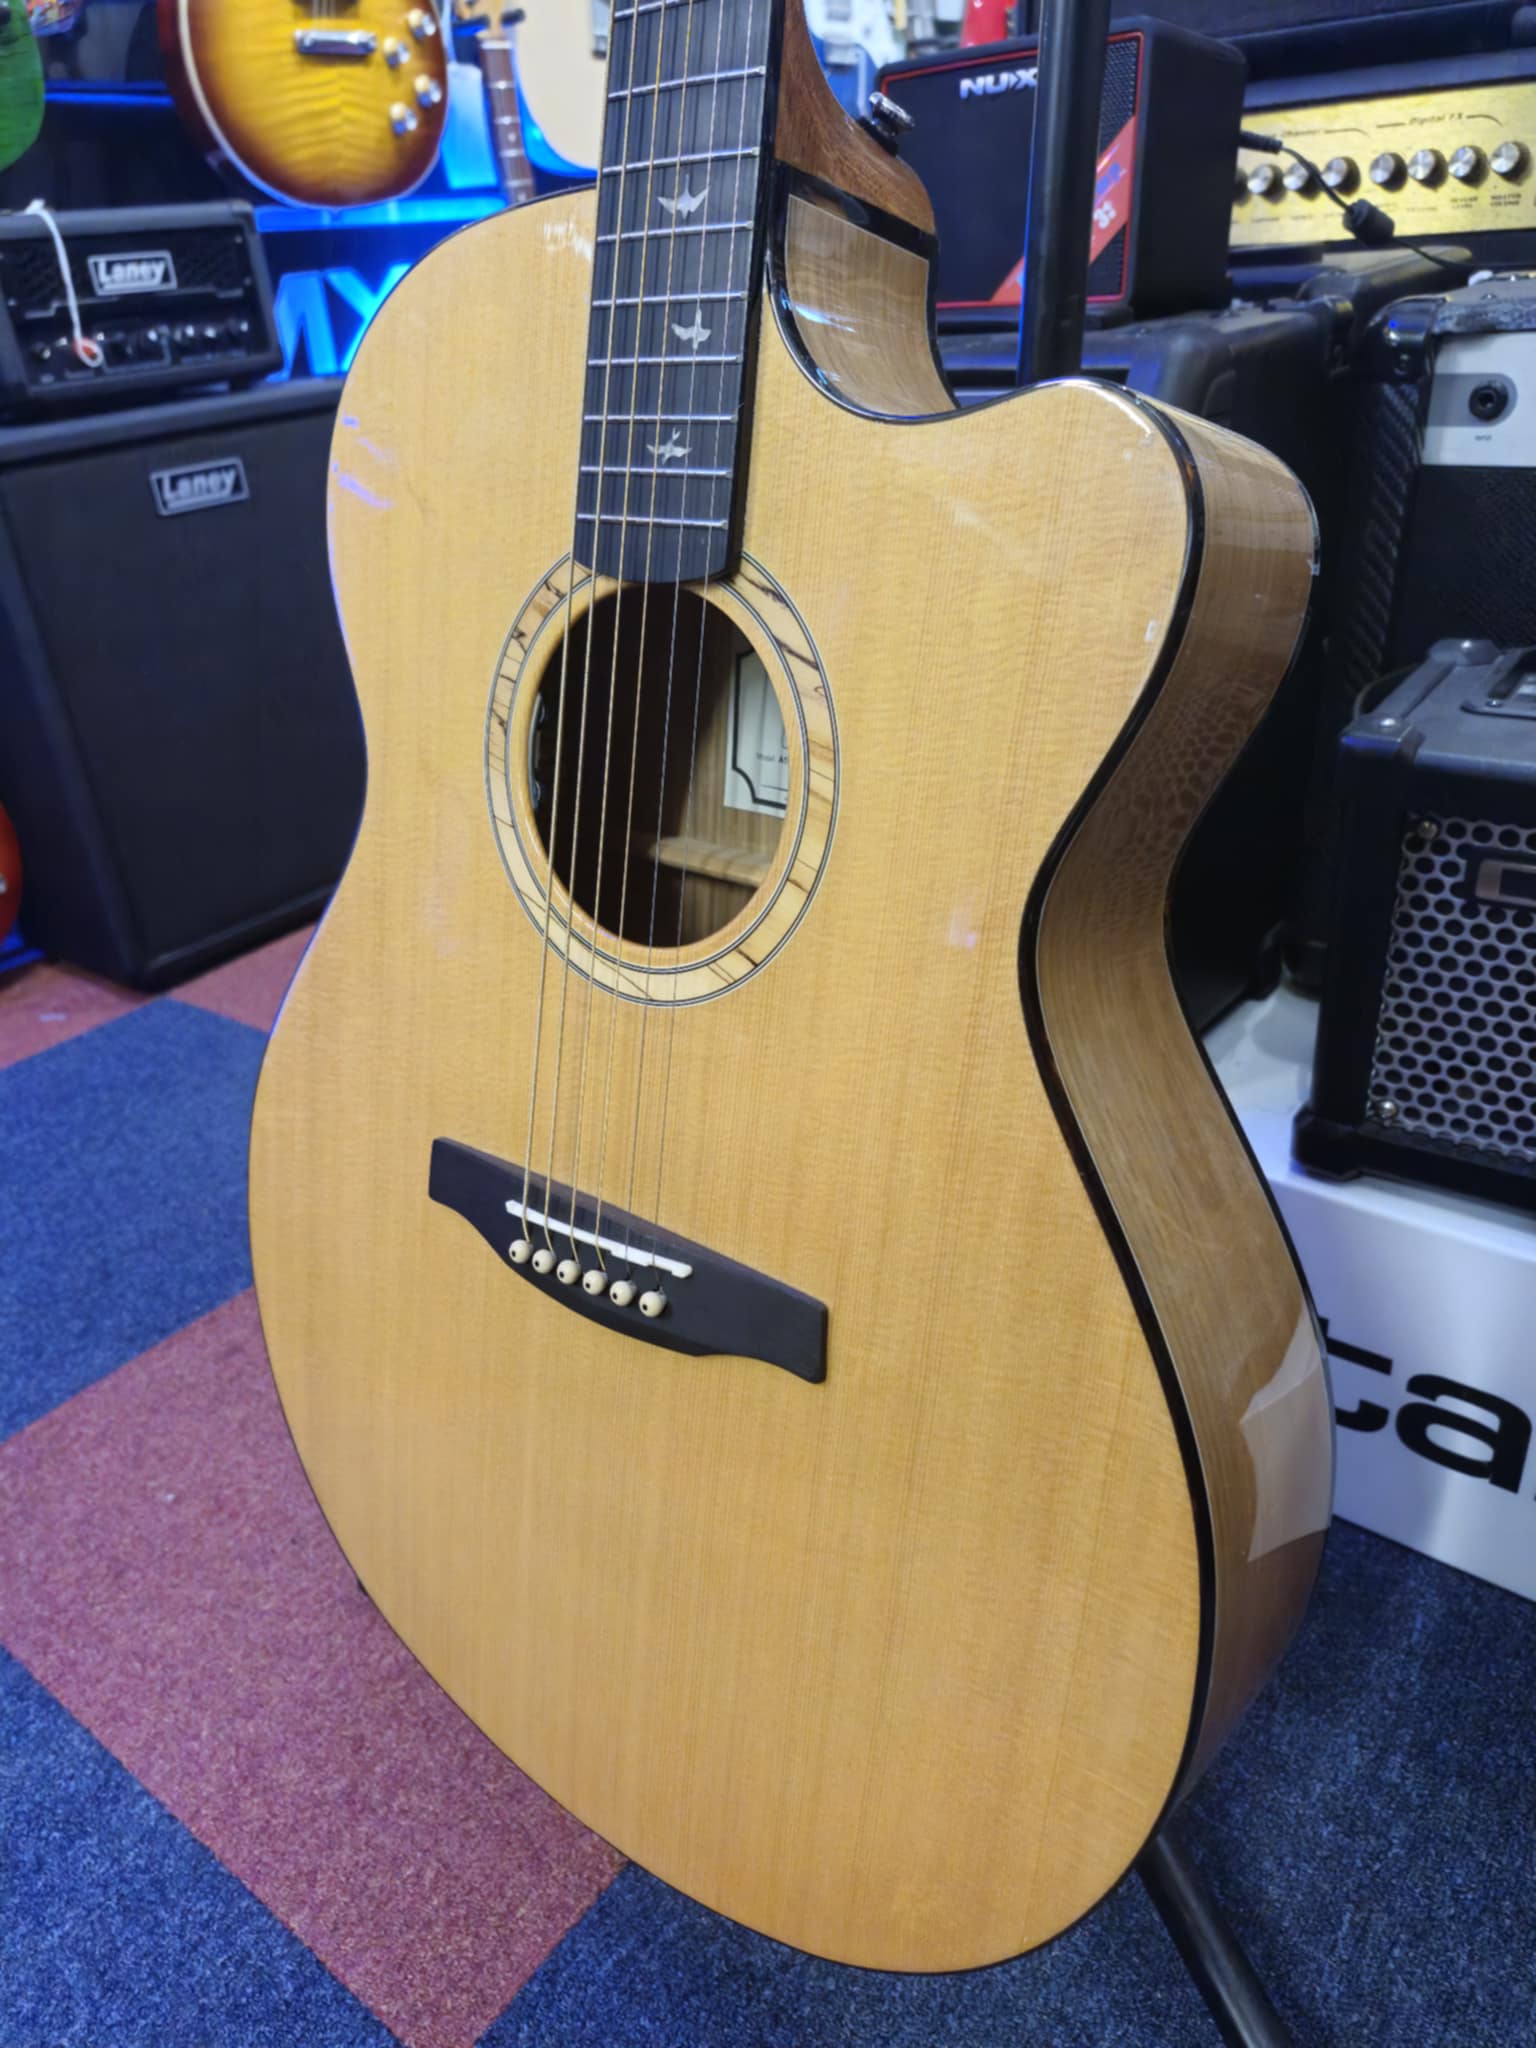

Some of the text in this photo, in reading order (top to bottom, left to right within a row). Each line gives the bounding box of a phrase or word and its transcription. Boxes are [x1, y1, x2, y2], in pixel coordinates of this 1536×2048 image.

[960, 67, 1038, 99] NUX
[98, 257, 166, 291] Laney
[162, 467, 237, 511] Laney
